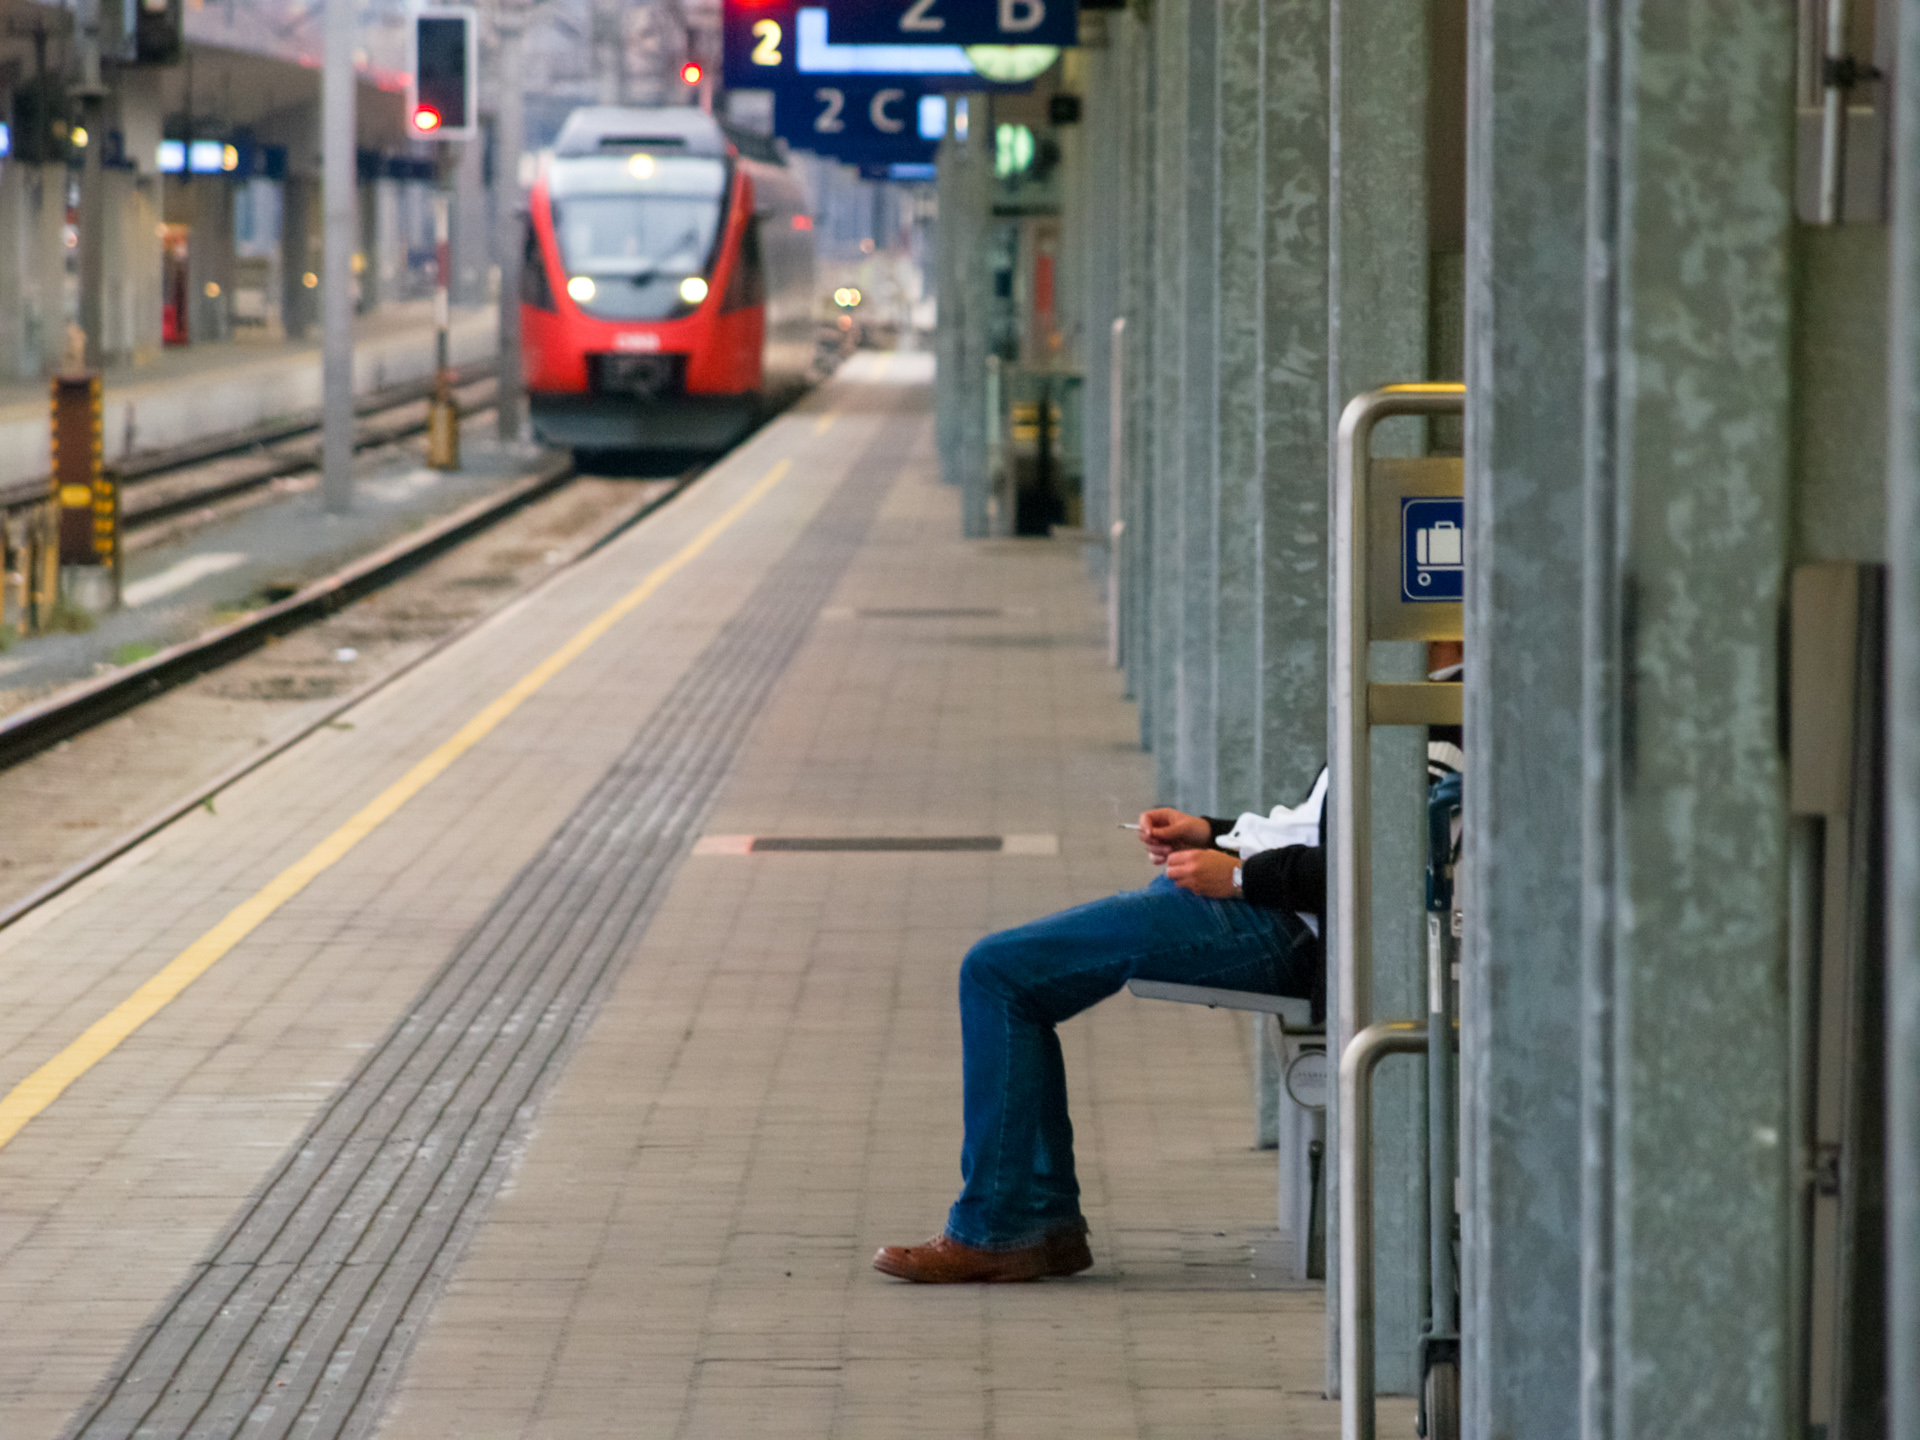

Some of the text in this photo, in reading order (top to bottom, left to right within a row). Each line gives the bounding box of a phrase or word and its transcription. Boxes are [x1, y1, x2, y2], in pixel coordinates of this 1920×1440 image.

[751, 18, 782, 66] 2
[814, 87, 905, 134] 2 C
